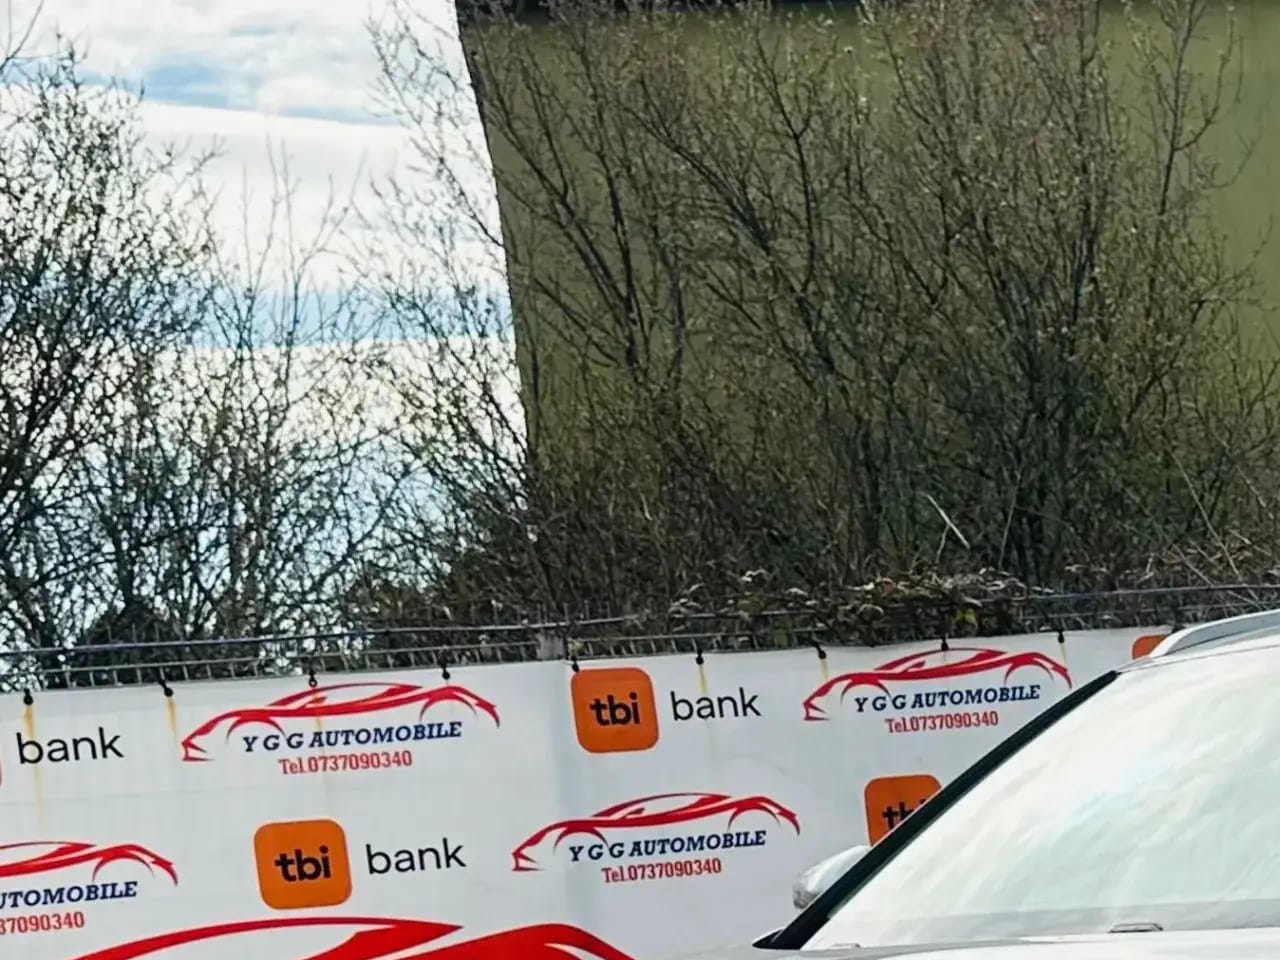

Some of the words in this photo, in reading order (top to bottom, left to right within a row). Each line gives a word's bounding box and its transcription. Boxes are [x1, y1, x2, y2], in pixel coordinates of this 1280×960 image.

[590, 692, 640, 726] tbi
[670, 687, 762, 721] bank
[911, 684, 1041, 709] AUTOMOBILE
[16, 726, 124, 764] bank
[309, 721, 463, 748] AUTOMOBILE
[275, 845, 332, 882] tbi
[366, 837, 467, 874] bank
[629, 830, 767, 857] AUTOMOBILE
